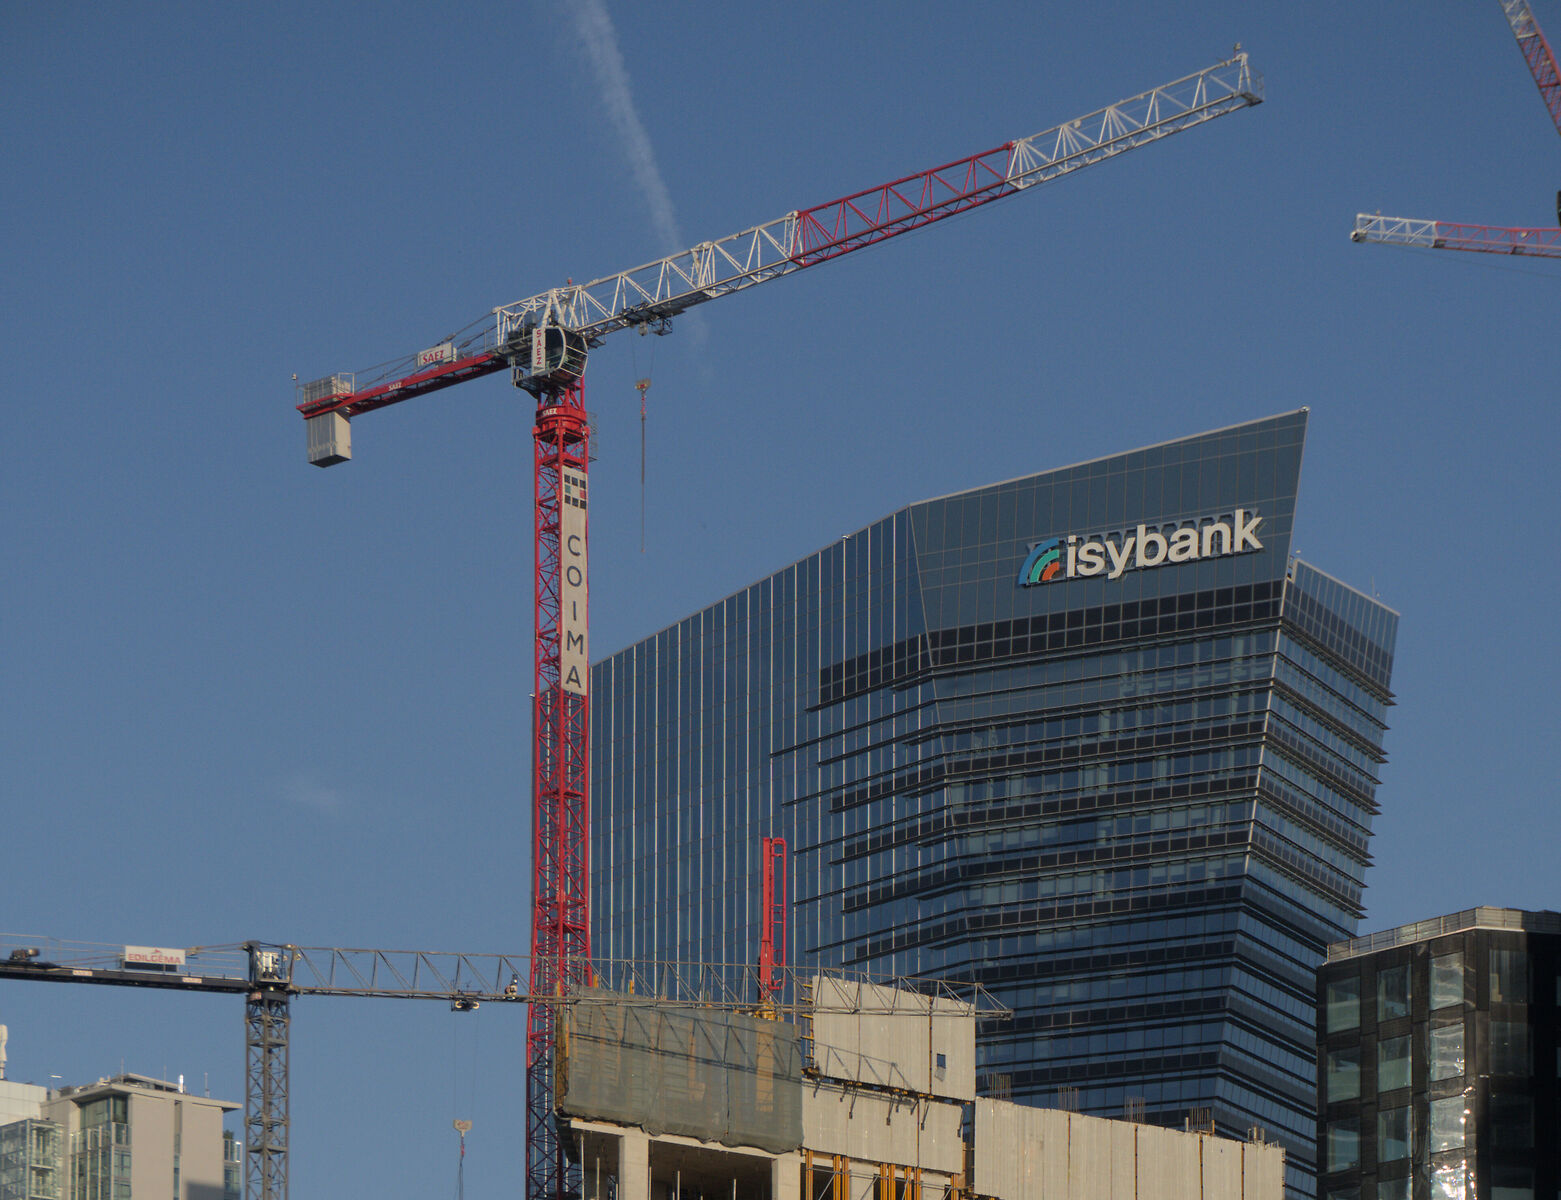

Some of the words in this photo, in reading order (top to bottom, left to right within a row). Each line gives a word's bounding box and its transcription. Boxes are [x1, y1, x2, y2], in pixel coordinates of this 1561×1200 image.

[422, 350, 445, 364] SAEZ
[1066, 509, 1264, 580] isybank
[566, 534, 583, 688] COIMA
